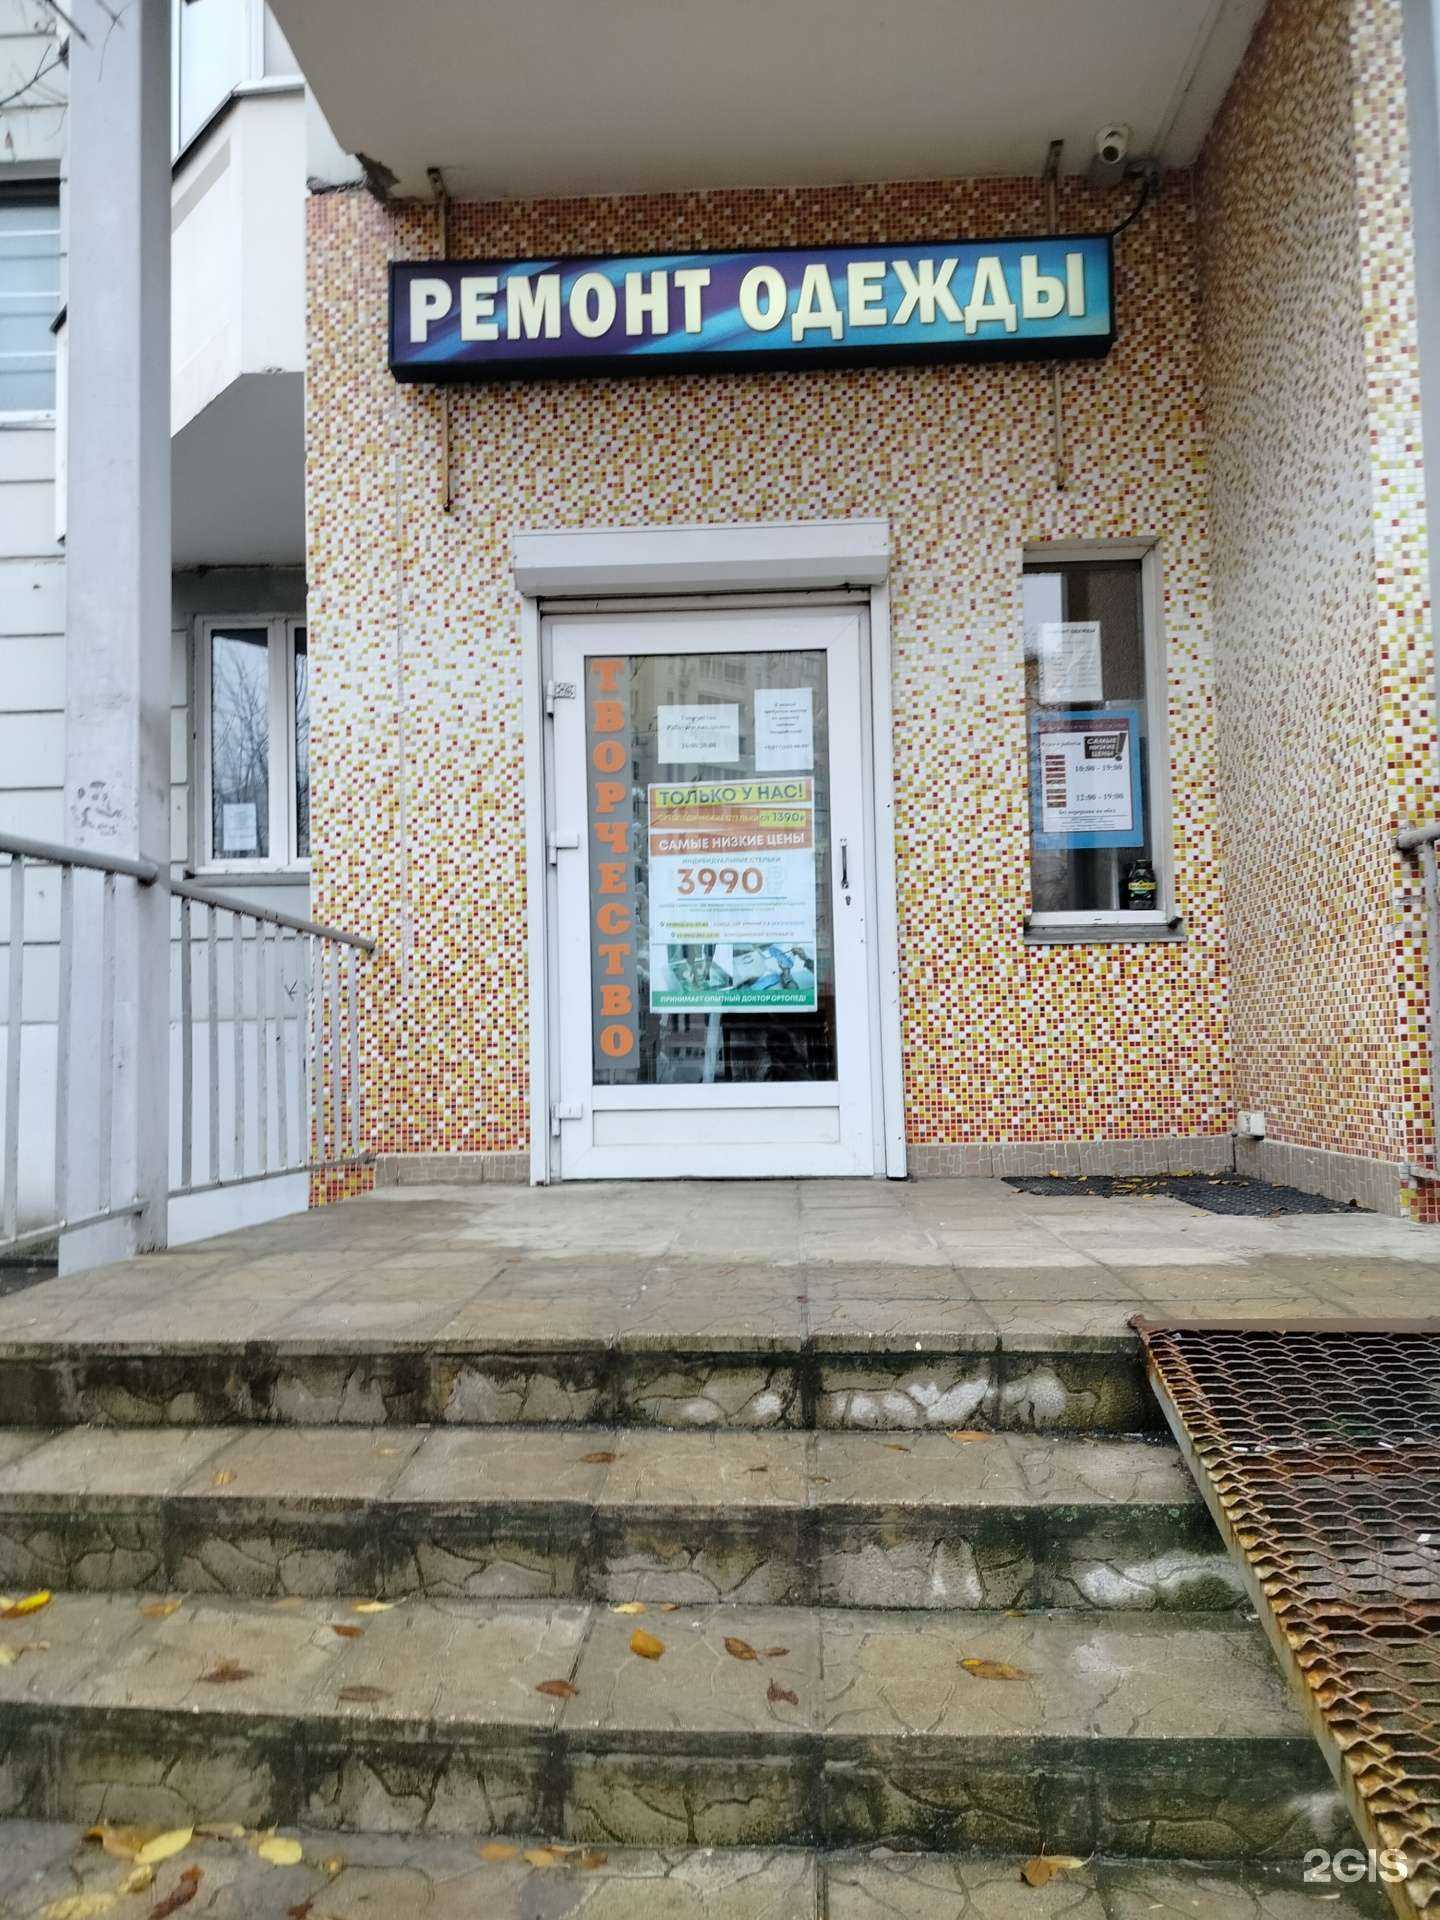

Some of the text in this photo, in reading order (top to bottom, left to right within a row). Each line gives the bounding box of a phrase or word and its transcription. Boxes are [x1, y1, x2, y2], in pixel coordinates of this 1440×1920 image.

[409, 252, 1086, 343] РЕМОНТ ОДЕЖДЫ
[660, 783, 804, 806] ТОЛЬКО У НАС!
[659, 832, 805, 851] САМЫЕ НИЗКИЕ ЦЕНЫ
[591, 659, 635, 1058] ТВОРЧЕСТВО
[676, 867, 764, 895] 3990
